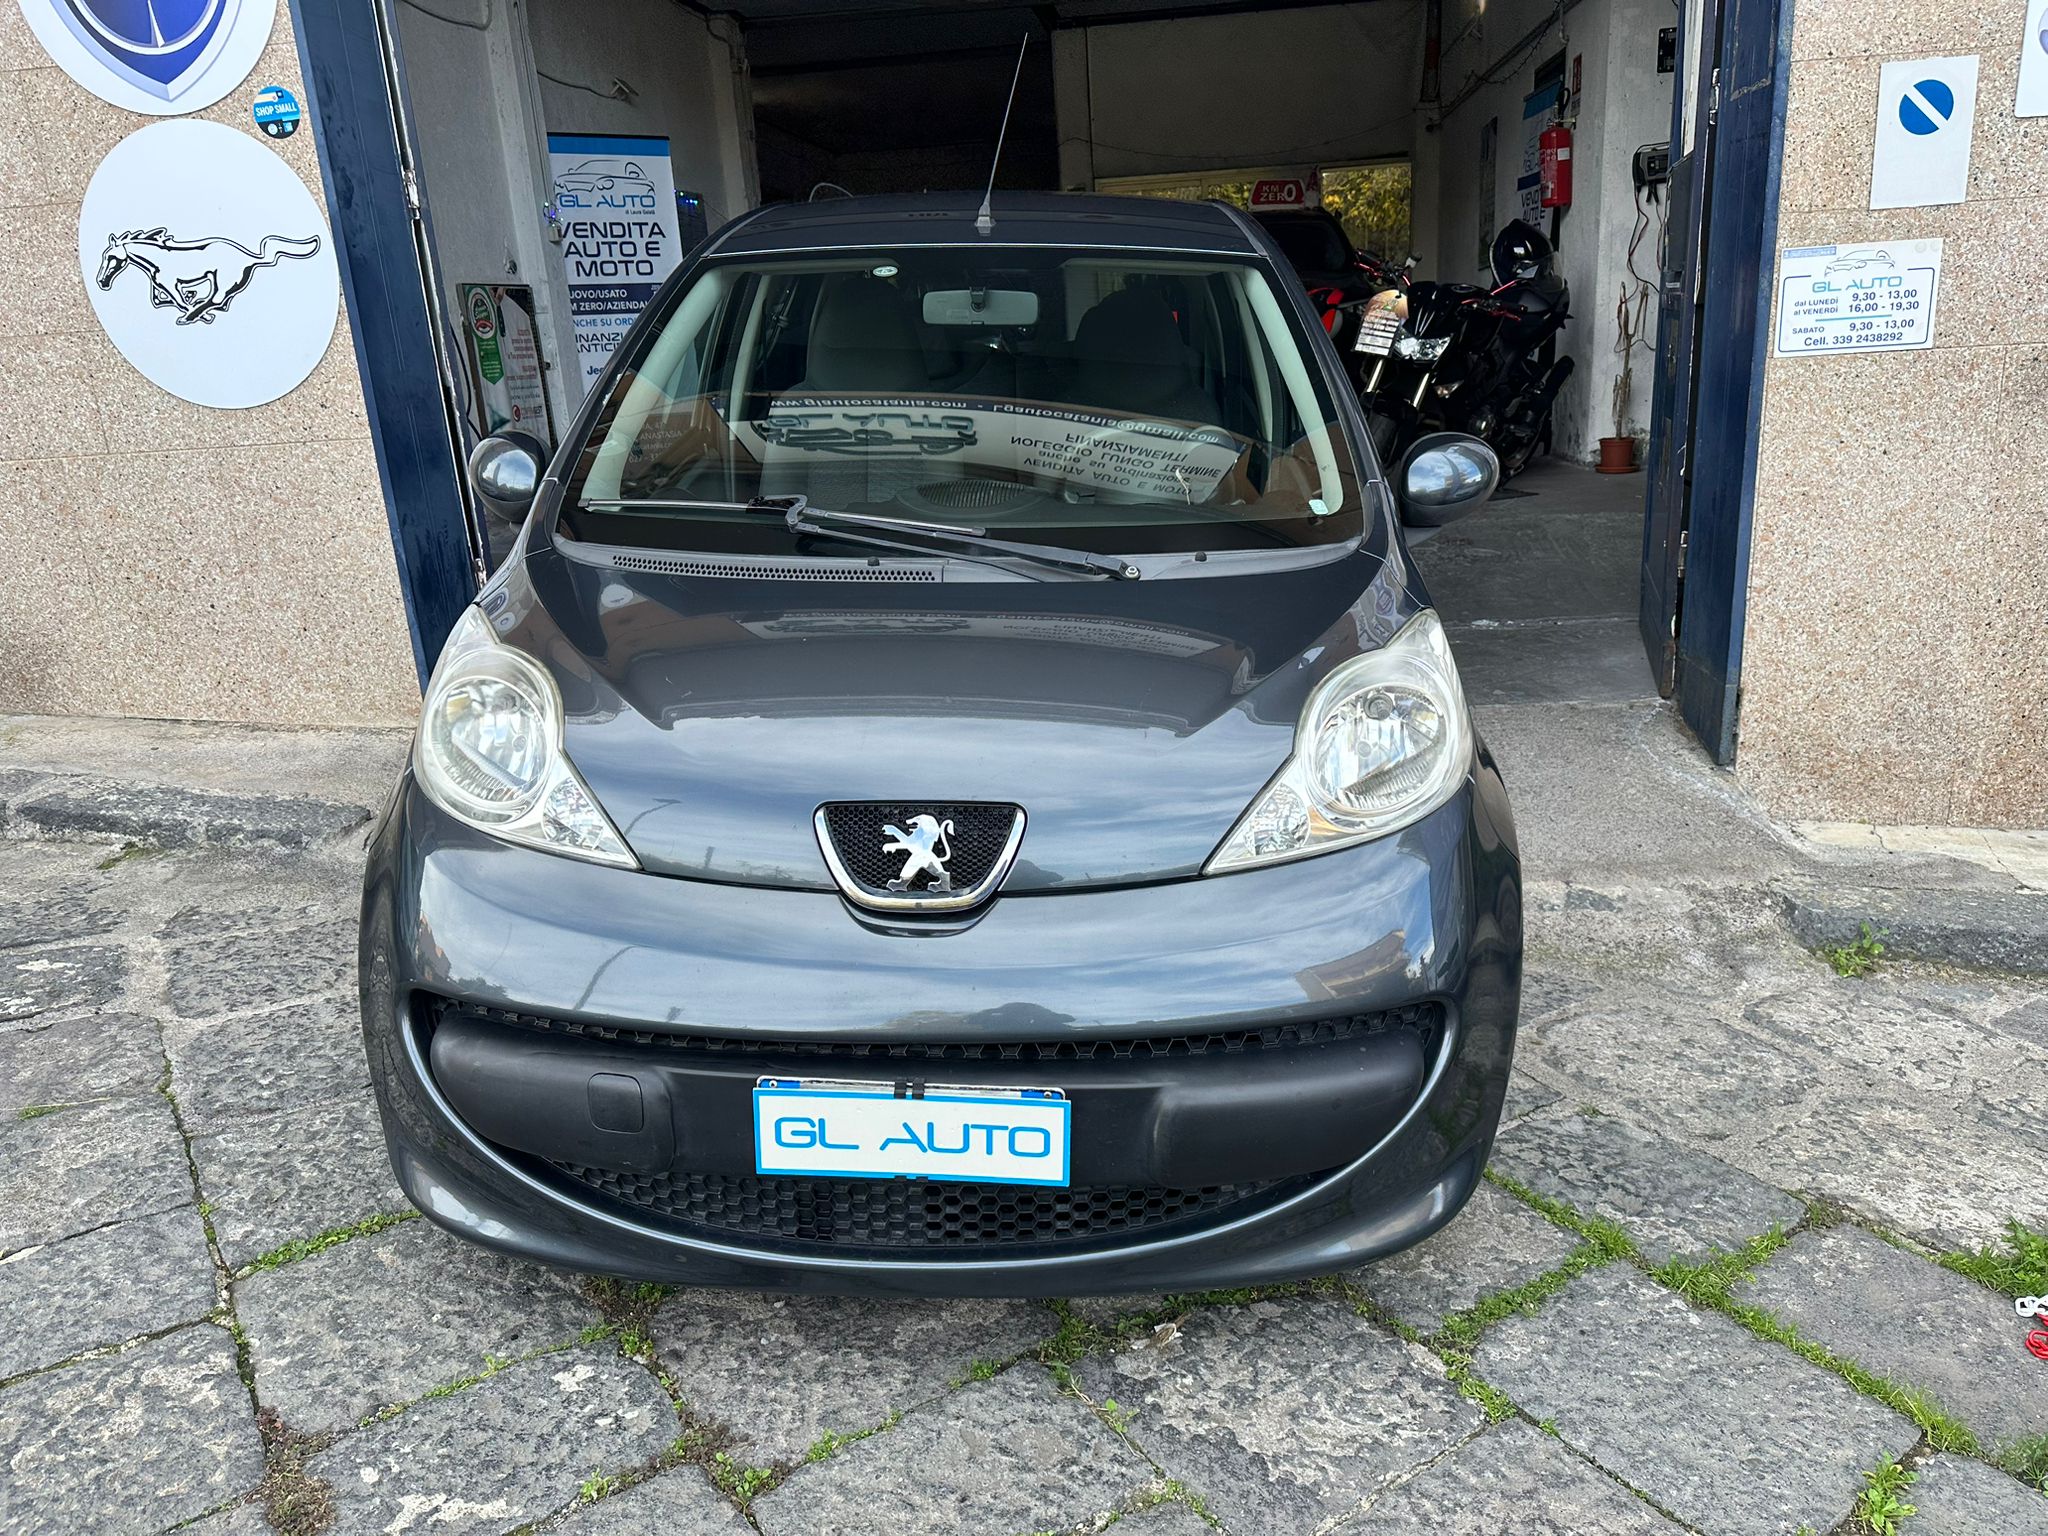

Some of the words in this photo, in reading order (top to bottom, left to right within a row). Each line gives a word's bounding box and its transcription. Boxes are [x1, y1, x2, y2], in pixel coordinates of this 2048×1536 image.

[255, 106, 275, 116] SHOP
[274, 102, 297, 114] SMALL
[1262, 185, 1280, 193] KM
[560, 194, 592, 208] GL
[596, 194, 656, 208] AUTO
[564, 241, 638, 258] AUTO
[645, 240, 662, 257] E
[575, 260, 654, 277] MOTO
[1812, 282, 1842, 293] GL
[1845, 276, 1902, 291] AUTO
[569, 289, 627, 299] UOVO/USATO
[1794, 299, 1807, 307] dal
[1851, 291, 1876, 302] 9,30
[1887, 288, 1918, 301] 13,00
[579, 301, 648, 311] ZERO/AZIENDA
[1793, 308, 1801, 316] al
[1849, 302, 1878, 314] 16,00
[1889, 300, 1920, 312] 19,30
[573, 318, 598, 328] NCHE
[600, 318, 612, 327] SU
[614, 317, 636, 327] ORD
[1792, 326, 1825, 335] SABATO
[1849, 321, 1873, 332] 9,30
[1884, 318, 1915, 331] 13,00
[1804, 336, 1829, 347] Cell.
[1832, 335, 1853, 345] 339
[1855, 331, 1904, 343] 2438292
[774, 1116, 860, 1151] GL
[879, 1121, 1051, 1159] AUTO
